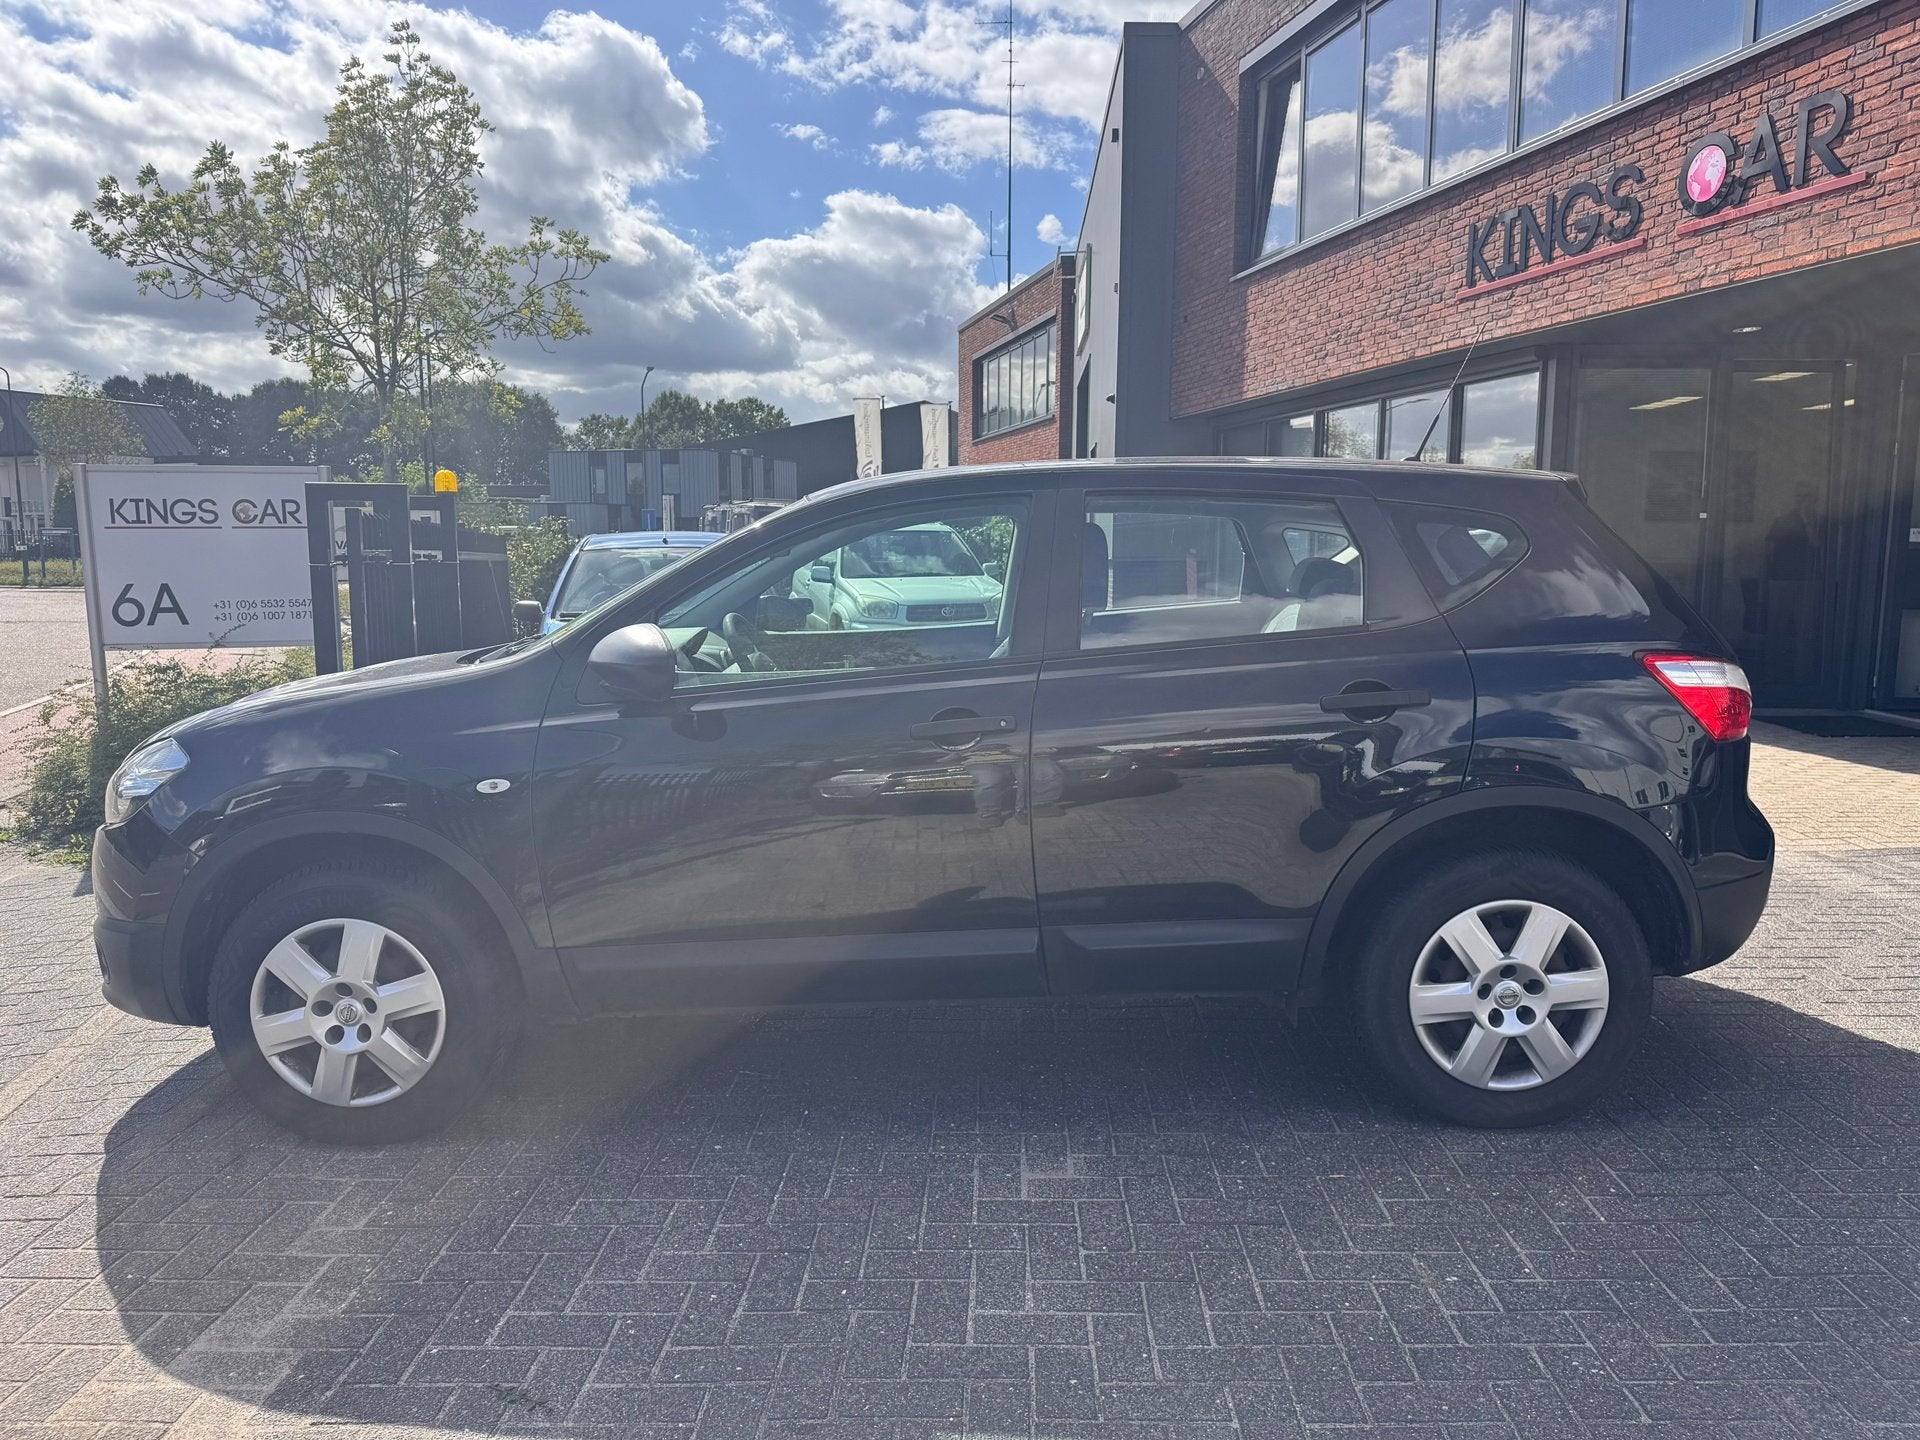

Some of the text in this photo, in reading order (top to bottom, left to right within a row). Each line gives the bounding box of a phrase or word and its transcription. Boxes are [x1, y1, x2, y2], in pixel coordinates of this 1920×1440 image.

[1466, 90, 1853, 289] KINGS CAR
[108, 498, 302, 525] KINGS CAR
[111, 582, 190, 628] 6A
[213, 599, 312, 611] +31 (0)6 5532 5547
[214, 610, 313, 622] +31 (0)6 1007 1871
